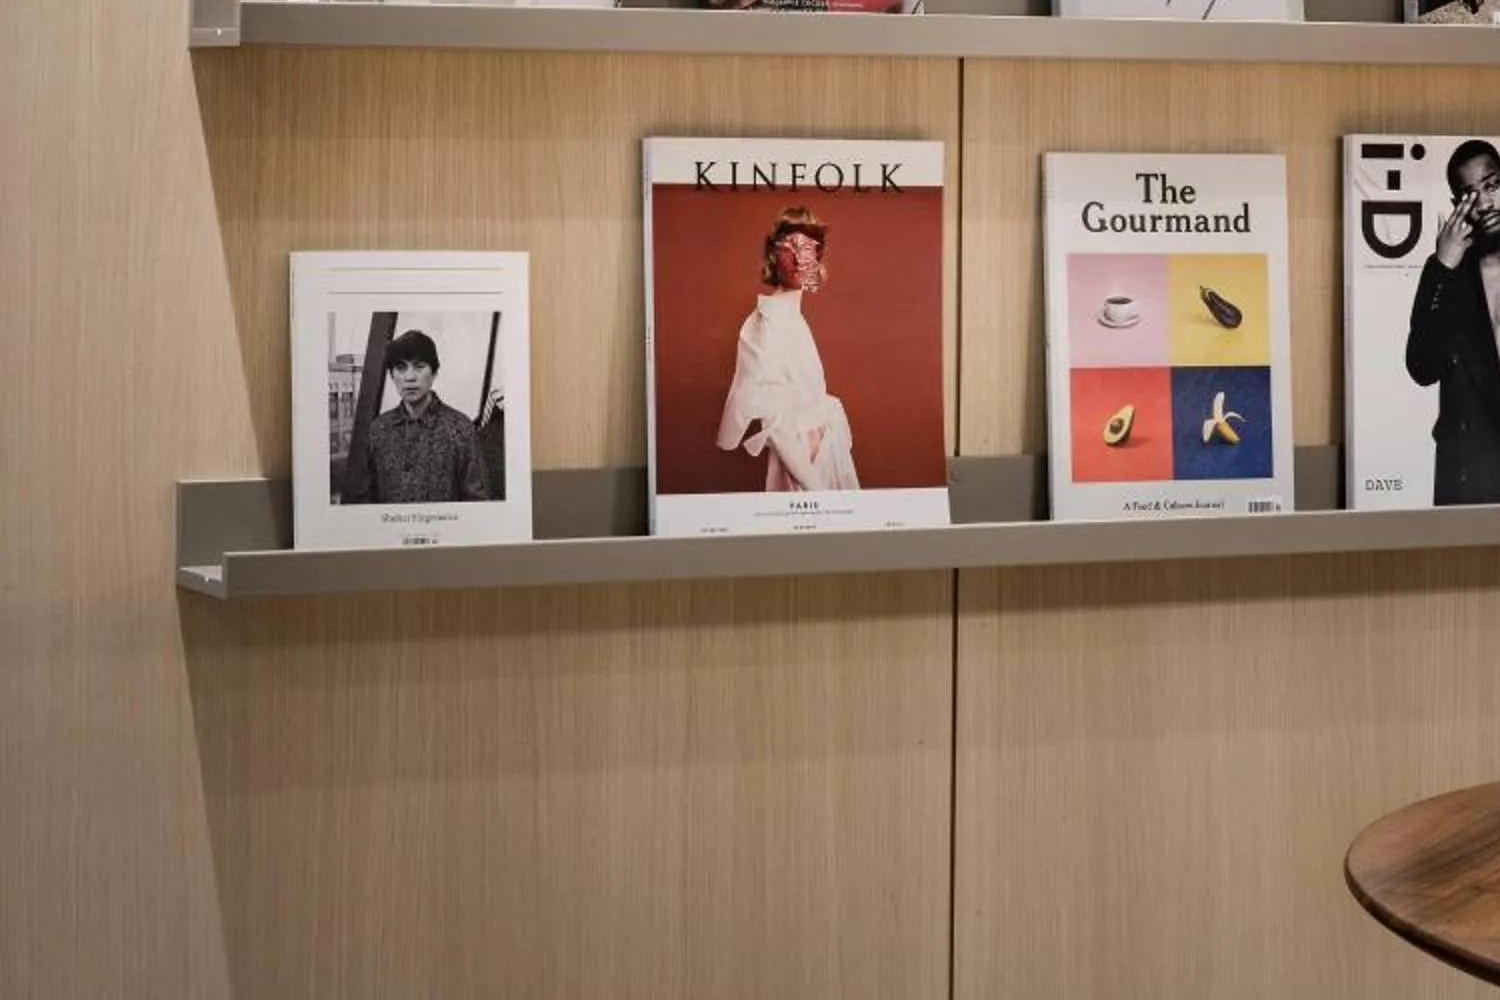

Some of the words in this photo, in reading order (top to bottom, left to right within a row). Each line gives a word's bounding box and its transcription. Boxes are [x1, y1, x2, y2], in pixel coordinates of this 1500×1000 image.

[695, 161, 906, 194] KINFOLK
[1136, 173, 1196, 205] The
[1081, 201, 1251, 233] Gourmand
[1365, 479, 1404, 491] DAVE
